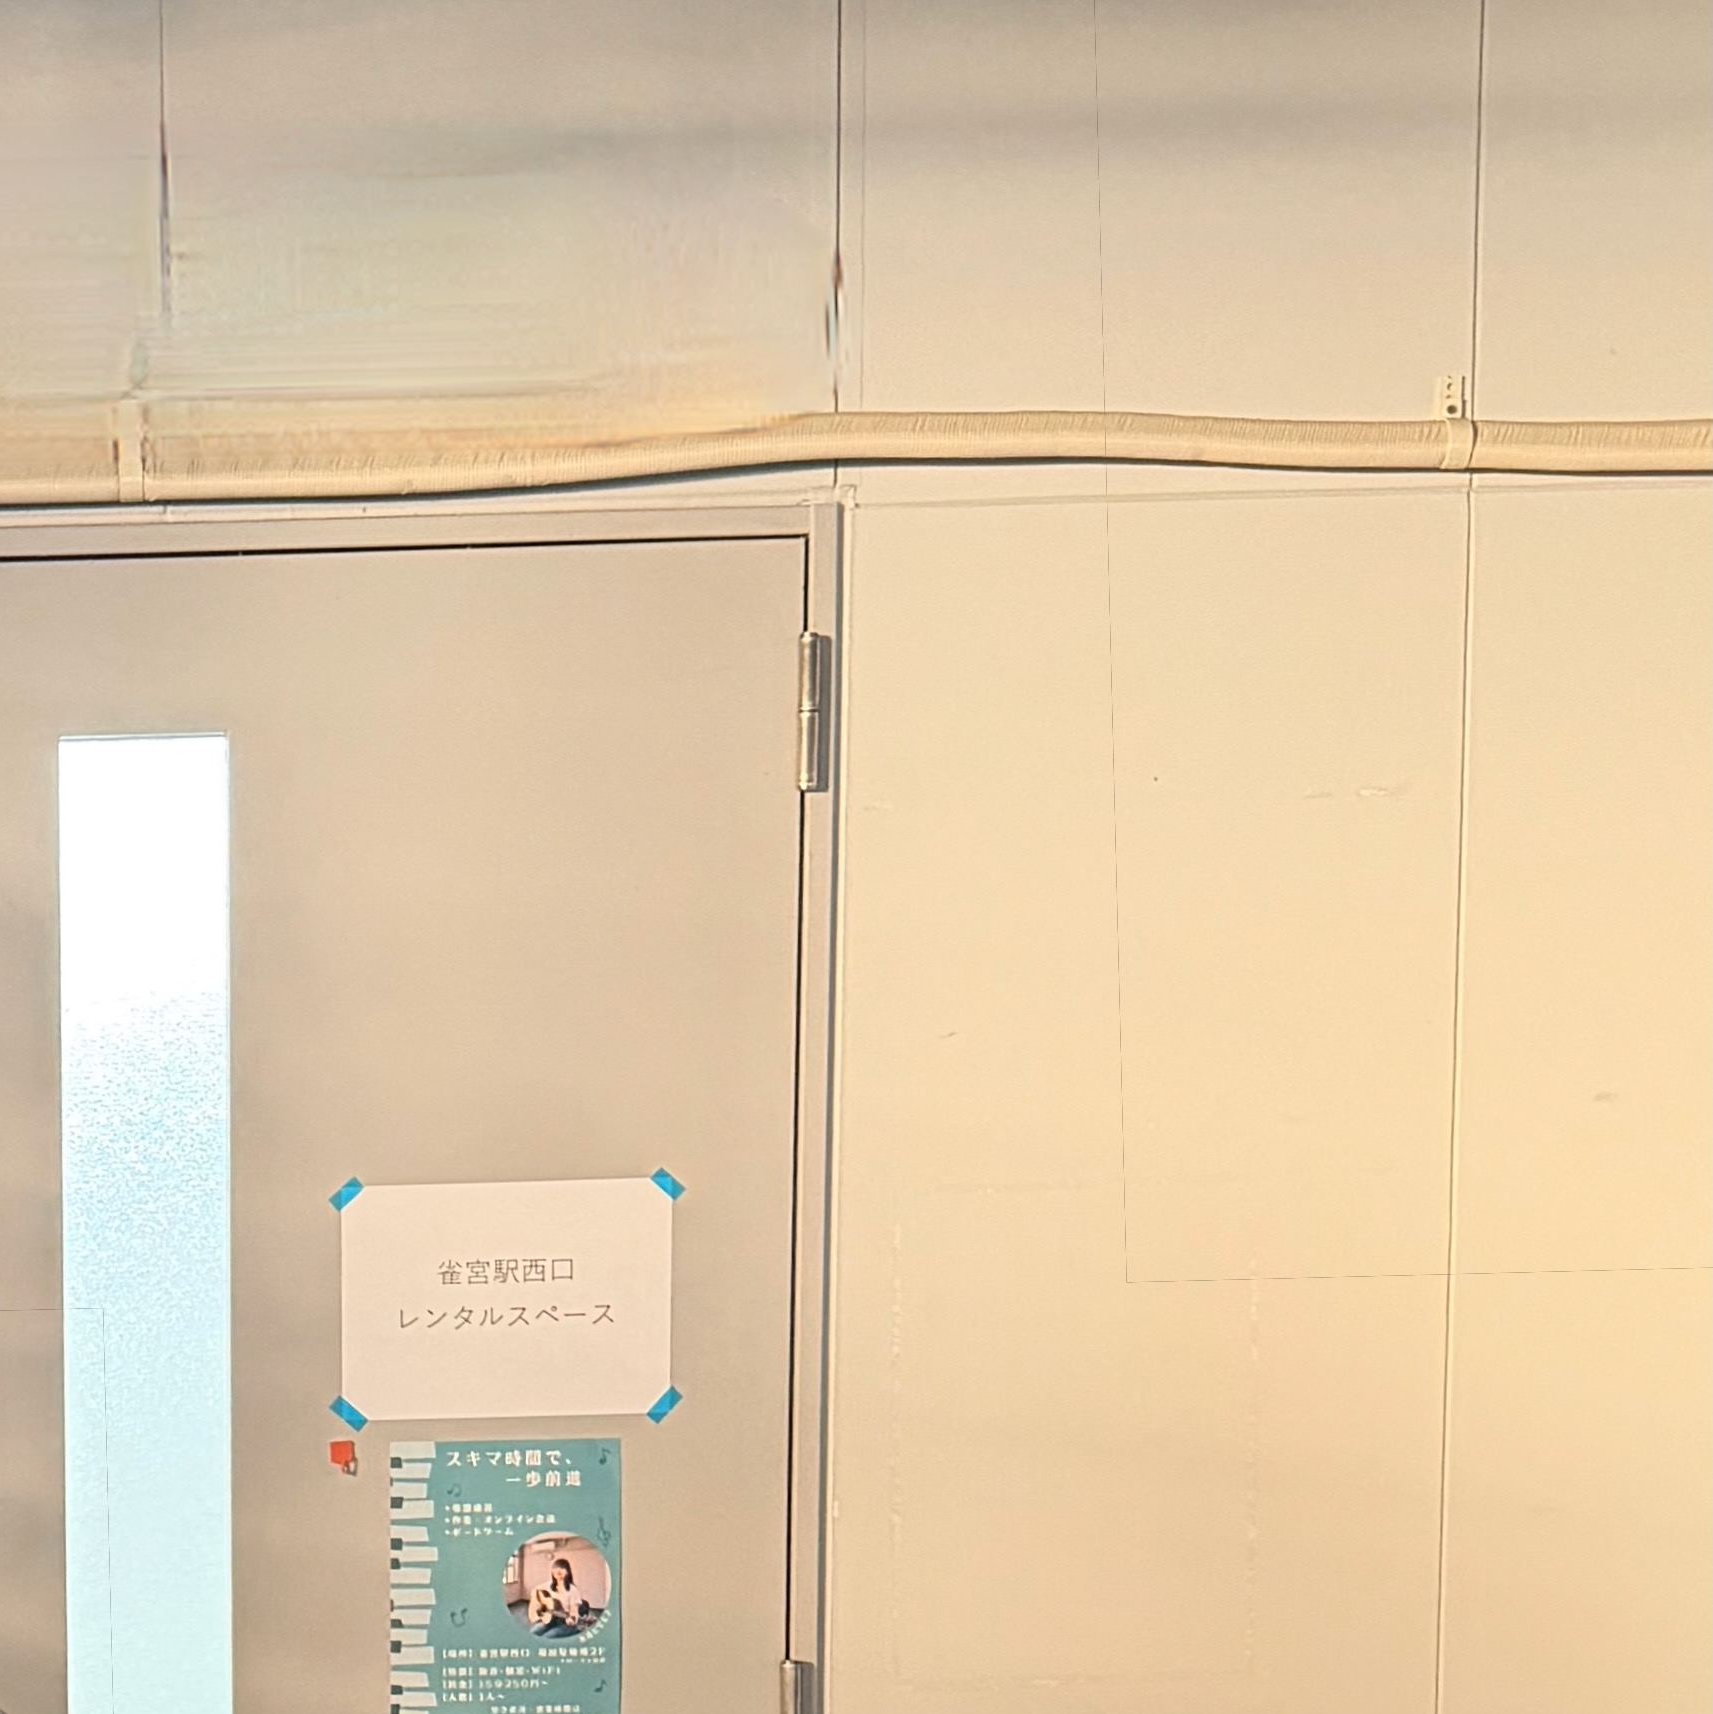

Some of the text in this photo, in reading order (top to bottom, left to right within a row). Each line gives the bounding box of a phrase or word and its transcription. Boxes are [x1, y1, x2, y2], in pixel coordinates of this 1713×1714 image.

[437, 1258, 574, 1286] 雀宮駅西口
[398, 1303, 615, 1331] レンタルスペース
